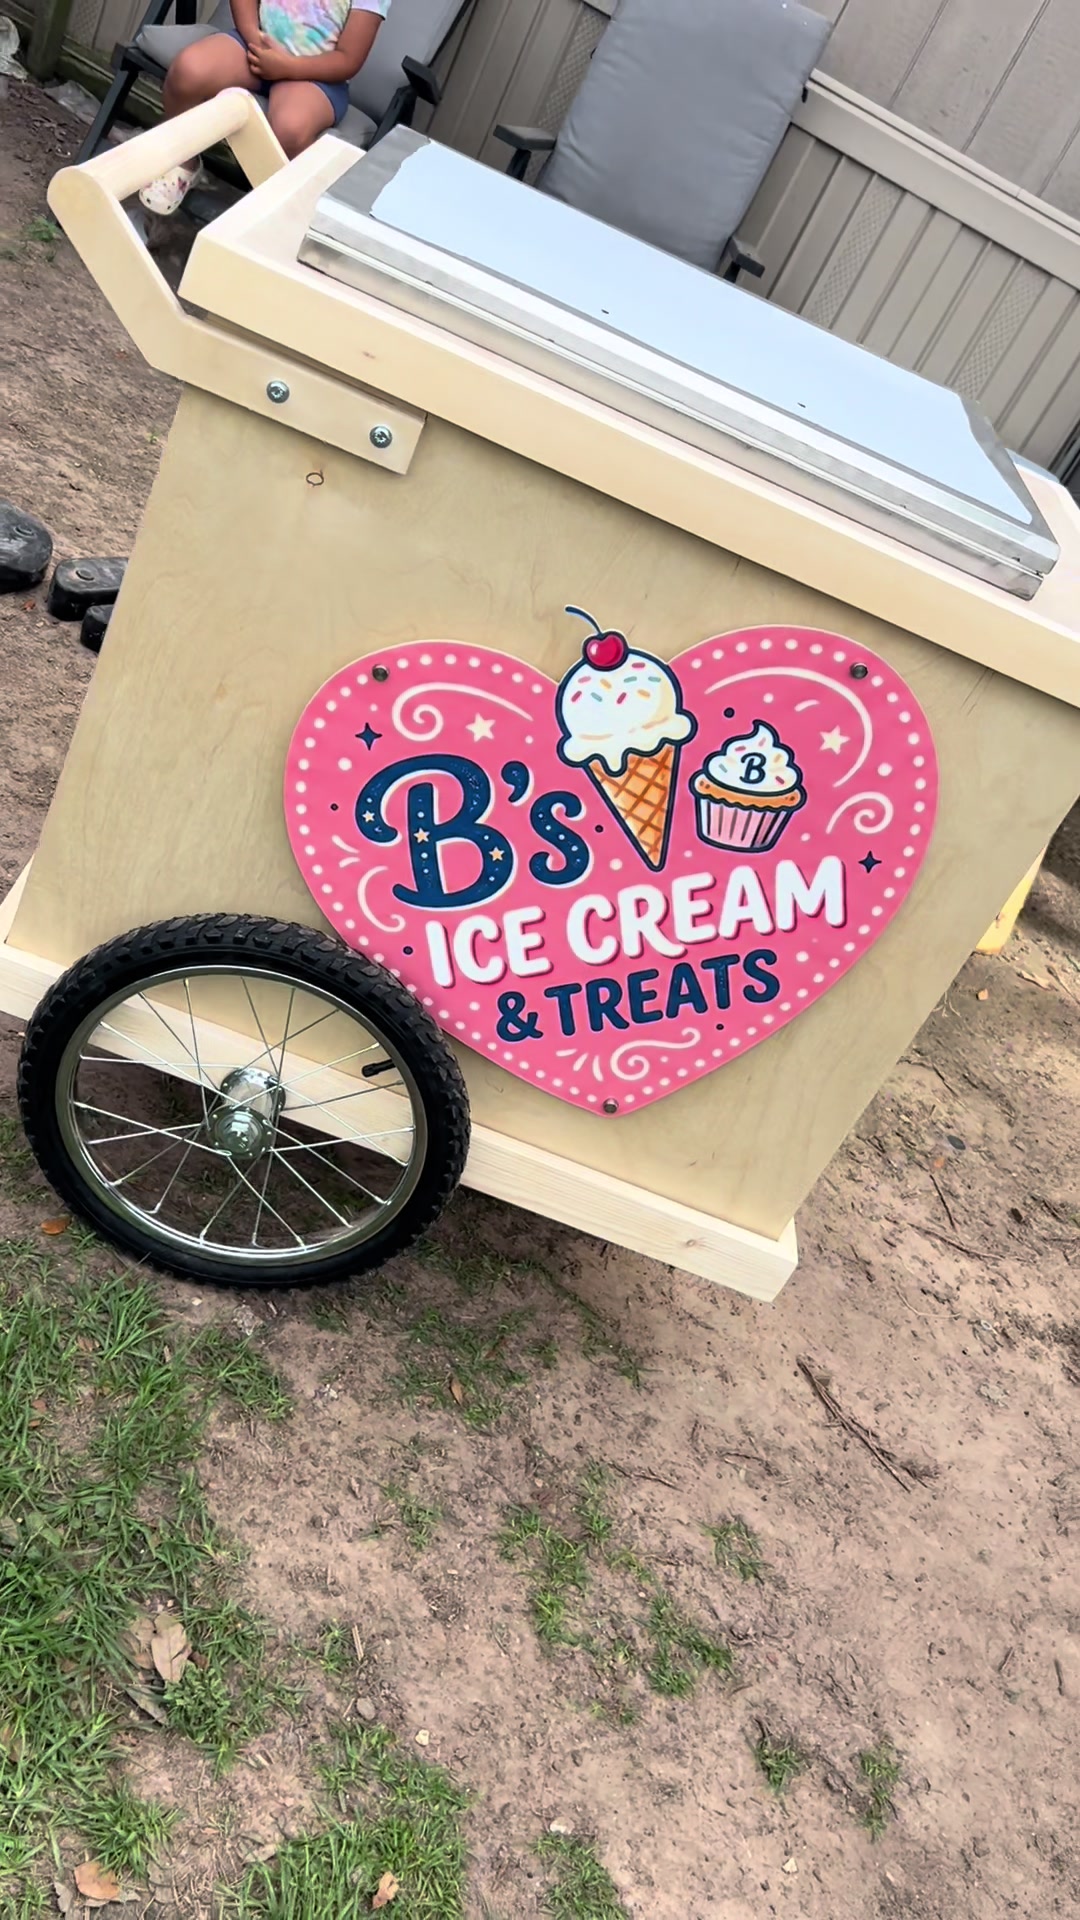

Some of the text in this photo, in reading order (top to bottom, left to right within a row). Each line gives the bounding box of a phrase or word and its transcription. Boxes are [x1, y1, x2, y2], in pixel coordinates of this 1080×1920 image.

[740, 751, 766, 784] B
[355, 753, 591, 908] B's
[425, 856, 847, 988] ICE CREAM
[496, 949, 780, 1042] & TREATS
